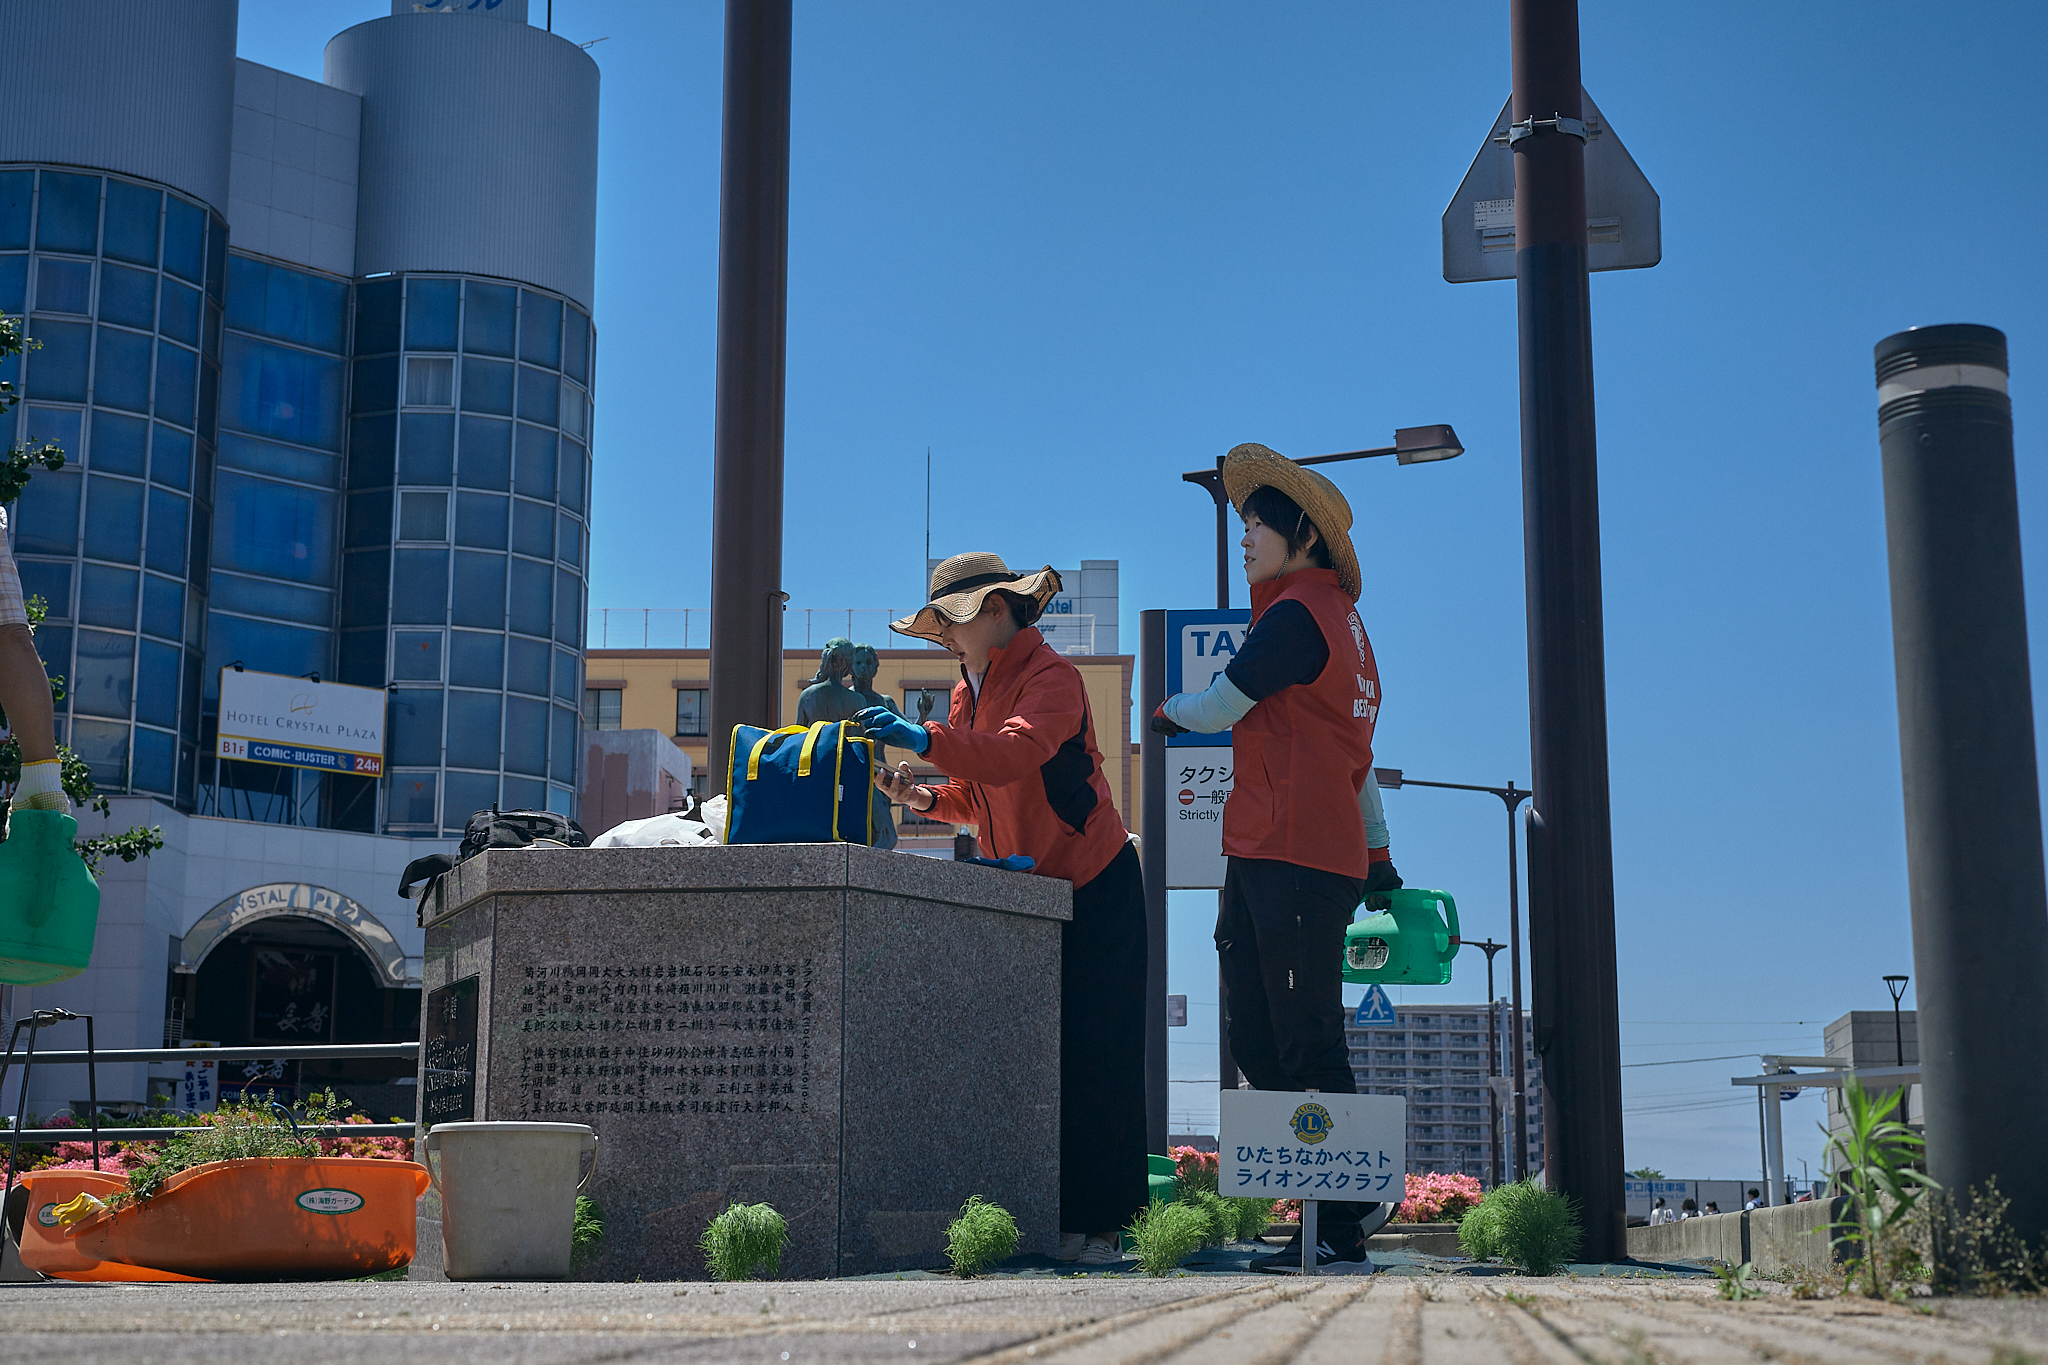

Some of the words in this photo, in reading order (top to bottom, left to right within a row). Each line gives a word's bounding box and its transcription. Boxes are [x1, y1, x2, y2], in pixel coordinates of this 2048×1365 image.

[1043, 599, 1072, 614] otel
[1191, 630, 1247, 657] TA
[227, 711, 269, 726] HOTEL
[276, 717, 331, 735] CRYSTAL
[337, 725, 377, 740] PLAZA
[223, 741, 245, 755] B1F
[356, 758, 380, 773] 24H
[1179, 809, 1220, 822] Strictly
[216, 888, 288, 926] CRYSTAL
[1299, 1104, 1325, 1113] LIONS
[1307, 1116, 1318, 1131] L
[1237, 1146, 1391, 1168] ひたちなかベスト
[1237, 1168, 1392, 1191] ライオンズクラブ
